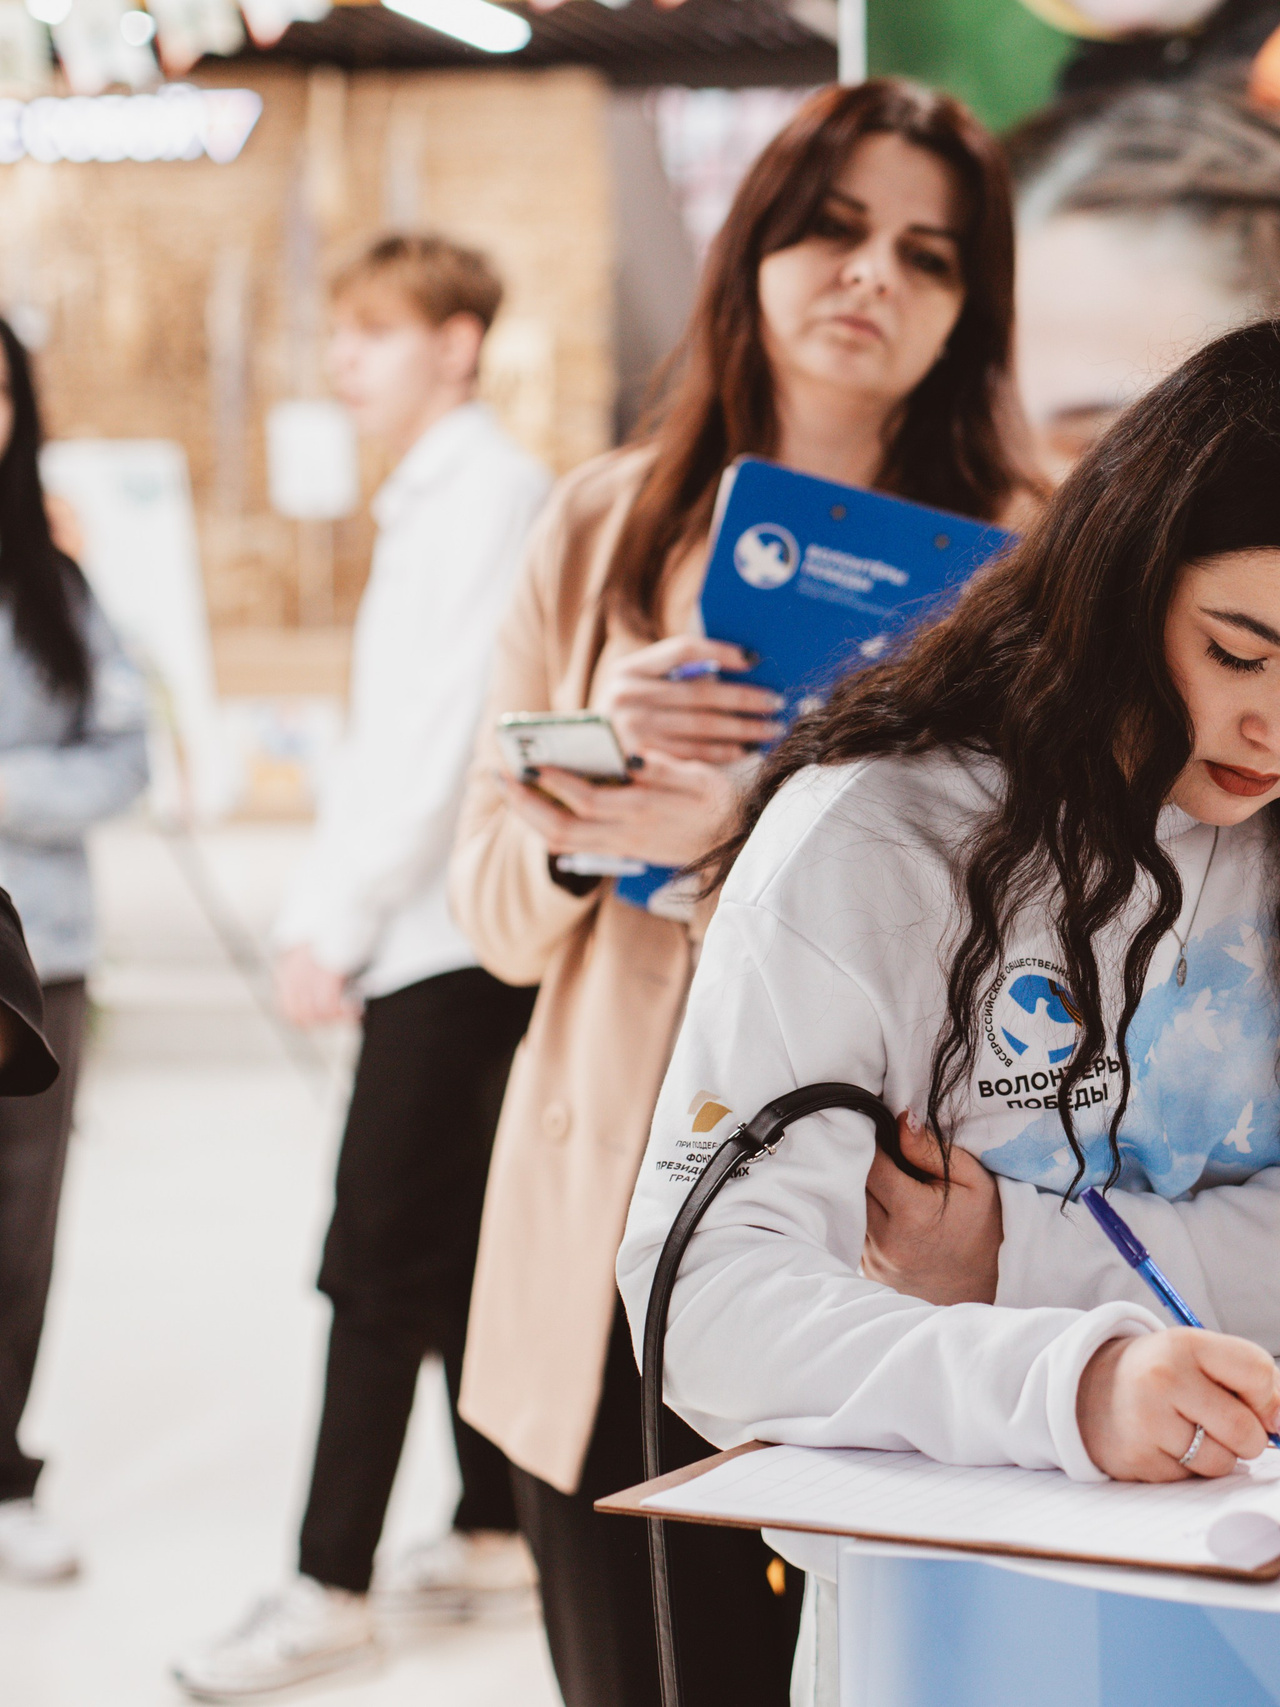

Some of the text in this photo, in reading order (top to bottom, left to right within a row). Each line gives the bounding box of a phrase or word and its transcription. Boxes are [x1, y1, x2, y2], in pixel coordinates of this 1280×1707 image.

[984, 957, 1072, 1068] ВСЕРОССИЙСКОЕ ОБЩЕСТВЕННО
[978, 1055, 1121, 1098] ВОЛОНРЫ
